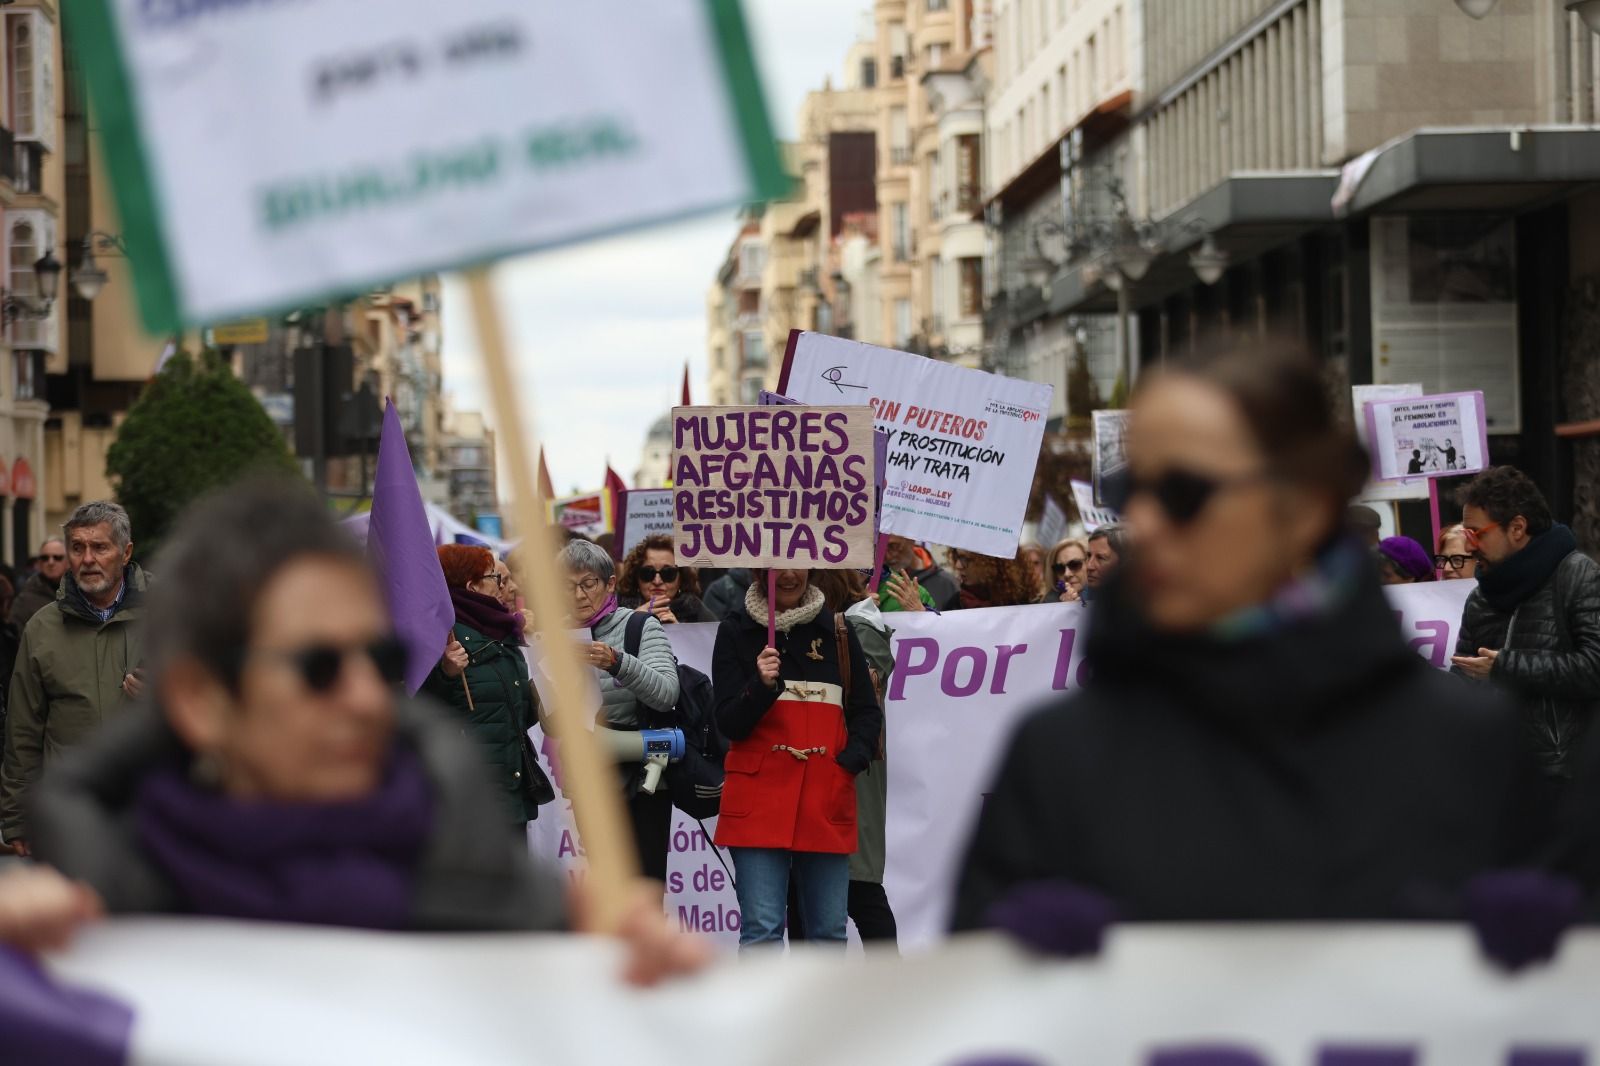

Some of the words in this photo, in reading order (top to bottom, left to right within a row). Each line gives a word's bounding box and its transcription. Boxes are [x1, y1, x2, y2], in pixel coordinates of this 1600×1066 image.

[675, 410, 849, 455] MUJERES
[869, 397, 902, 422] SIN
[903, 407, 988, 441] PUTEROS
[1403, 411, 1436, 421] FEMINISMO
[1411, 419, 1457, 429] ABOLICIONISTA
[899, 432, 1005, 466] PROSTITUCIÓN
[676, 452, 866, 493] AFGANAS
[888, 451, 921, 472] HAY
[924, 457, 970, 484] TRATA
[675, 490, 869, 526] RESISTIMOS
[908, 483, 931, 495] LOASP
[937, 490, 952, 500] LEY
[680, 522, 849, 563] JUNTAS
[888, 637, 1028, 701] Por
[692, 864, 725, 892] de
